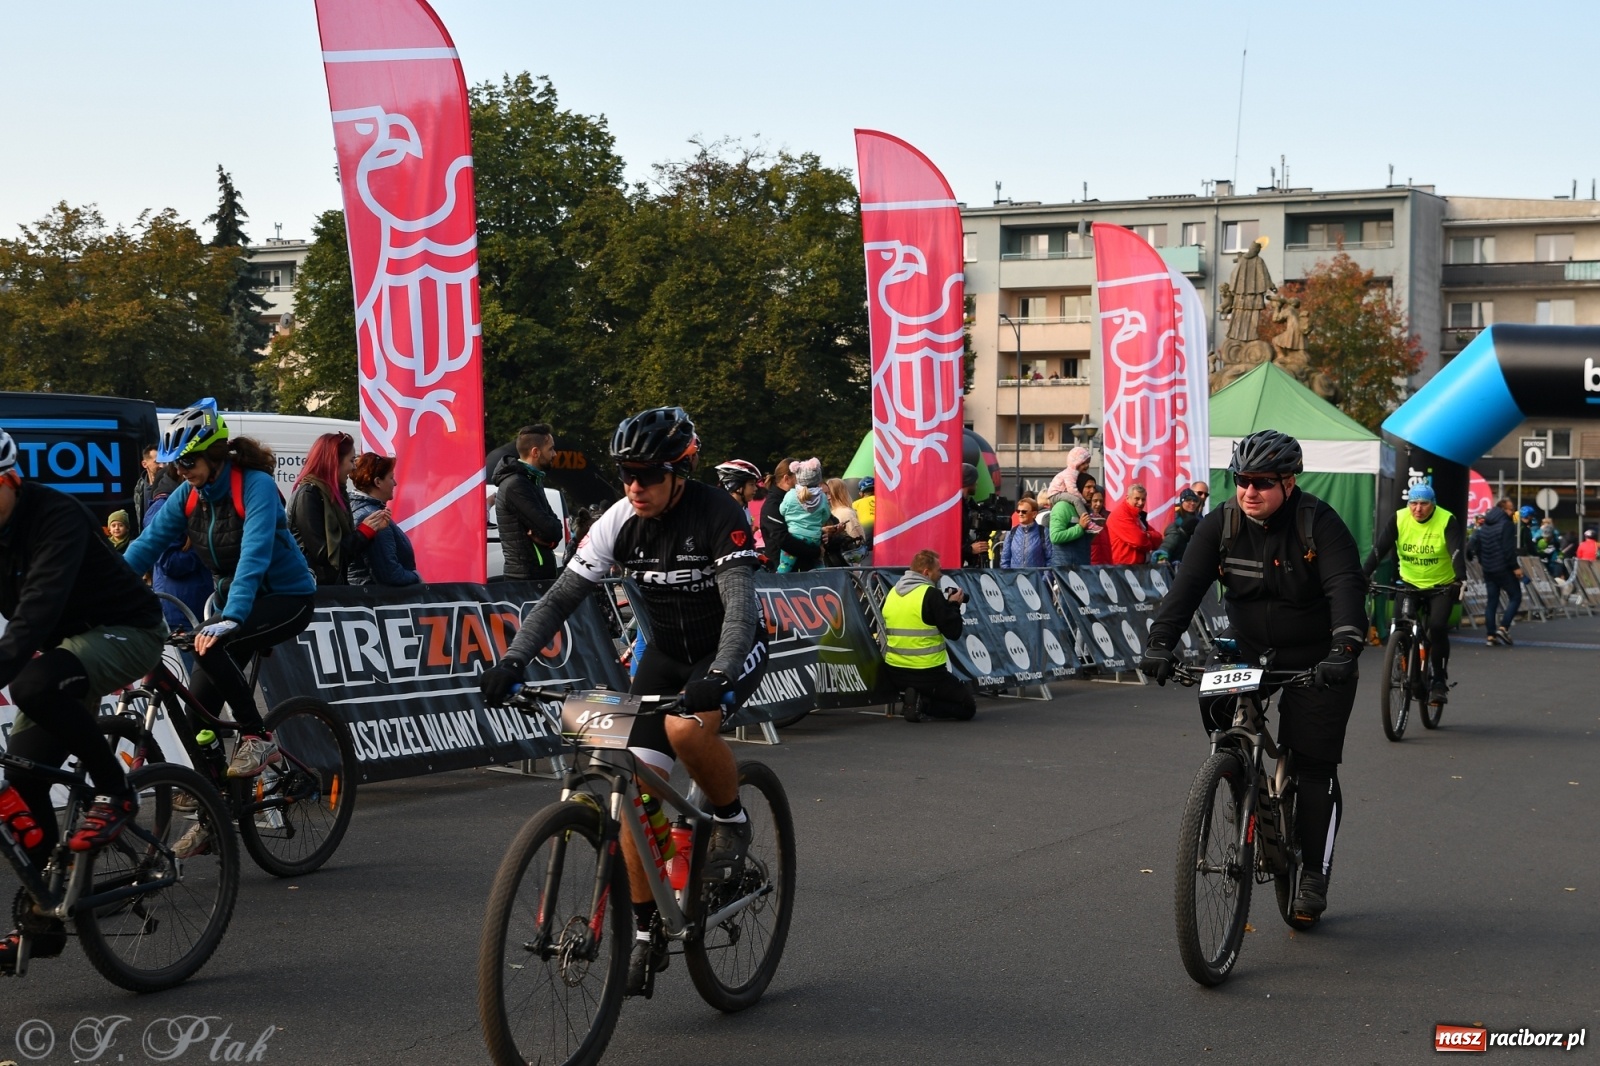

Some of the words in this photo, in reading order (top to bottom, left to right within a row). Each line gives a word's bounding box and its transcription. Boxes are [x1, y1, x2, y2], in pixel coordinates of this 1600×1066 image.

[1525, 446, 1542, 469] 0
[1212, 671, 1252, 685] 3185
[576, 710, 614, 730] 416
